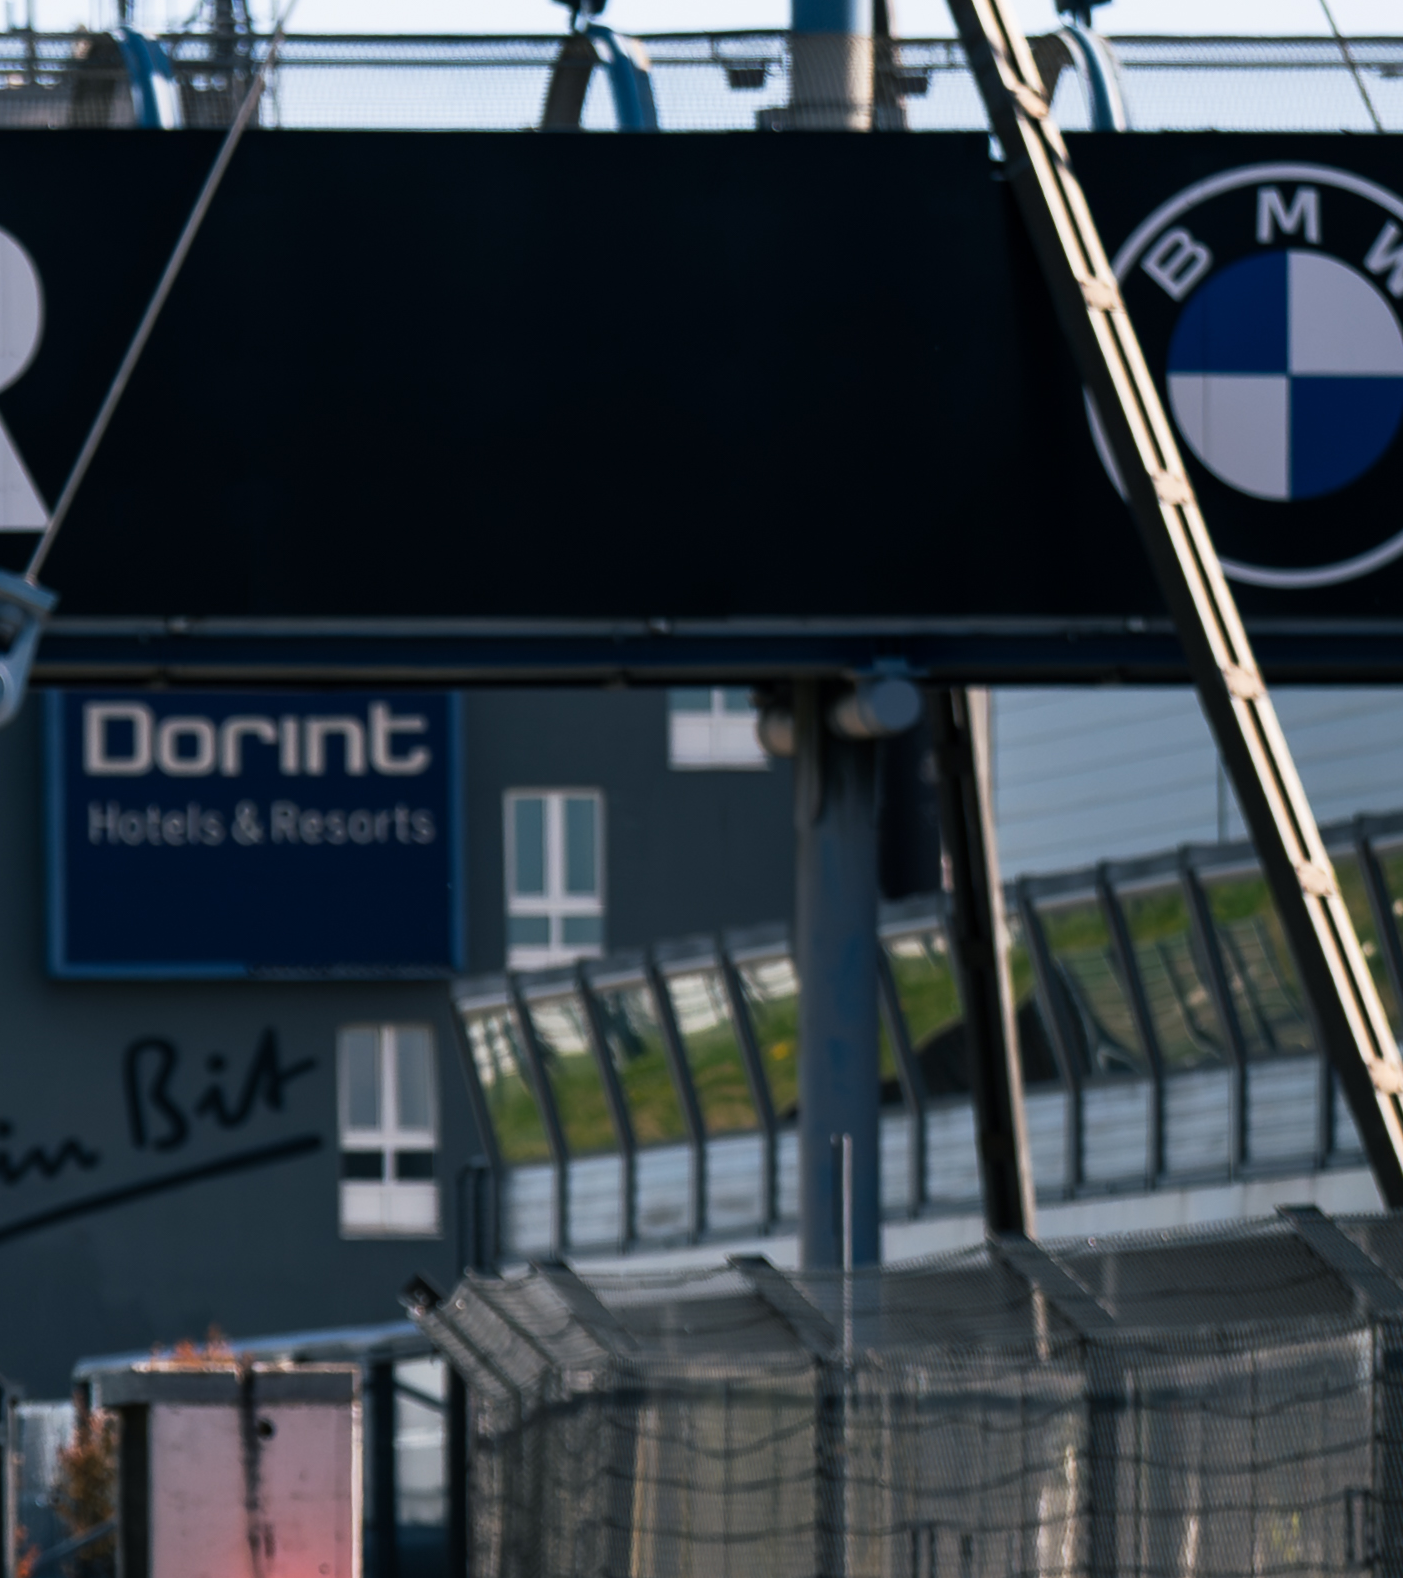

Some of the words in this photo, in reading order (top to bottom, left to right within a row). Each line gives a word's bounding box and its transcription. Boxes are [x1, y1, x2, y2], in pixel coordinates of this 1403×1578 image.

[82, 698, 432, 777] Dorint
[87, 798, 227, 846] Hotels
[231, 798, 266, 846] &
[270, 798, 438, 846] Resorts
[122, 1027, 319, 1153] Bit
